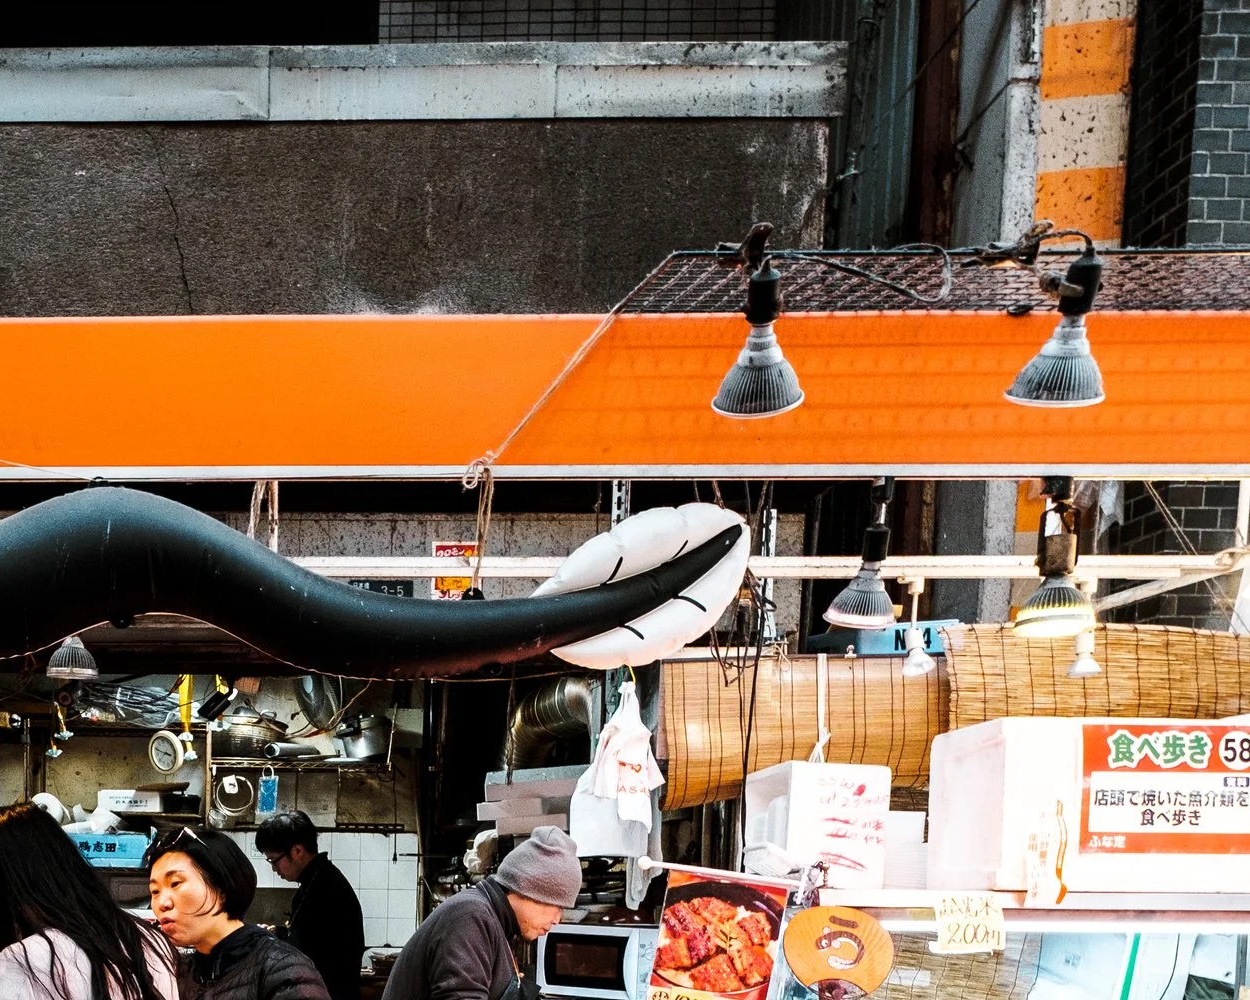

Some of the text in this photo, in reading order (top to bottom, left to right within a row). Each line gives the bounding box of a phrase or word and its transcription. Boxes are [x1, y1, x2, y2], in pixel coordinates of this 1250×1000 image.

[1111, 733, 1208, 765] 食べ歩き
[1094, 789, 1249, 808] 店頭で焼いた魚介類を
[1140, 808, 1201, 826] 食べ歩き
[1088, 835, 1126, 849] ふな定
